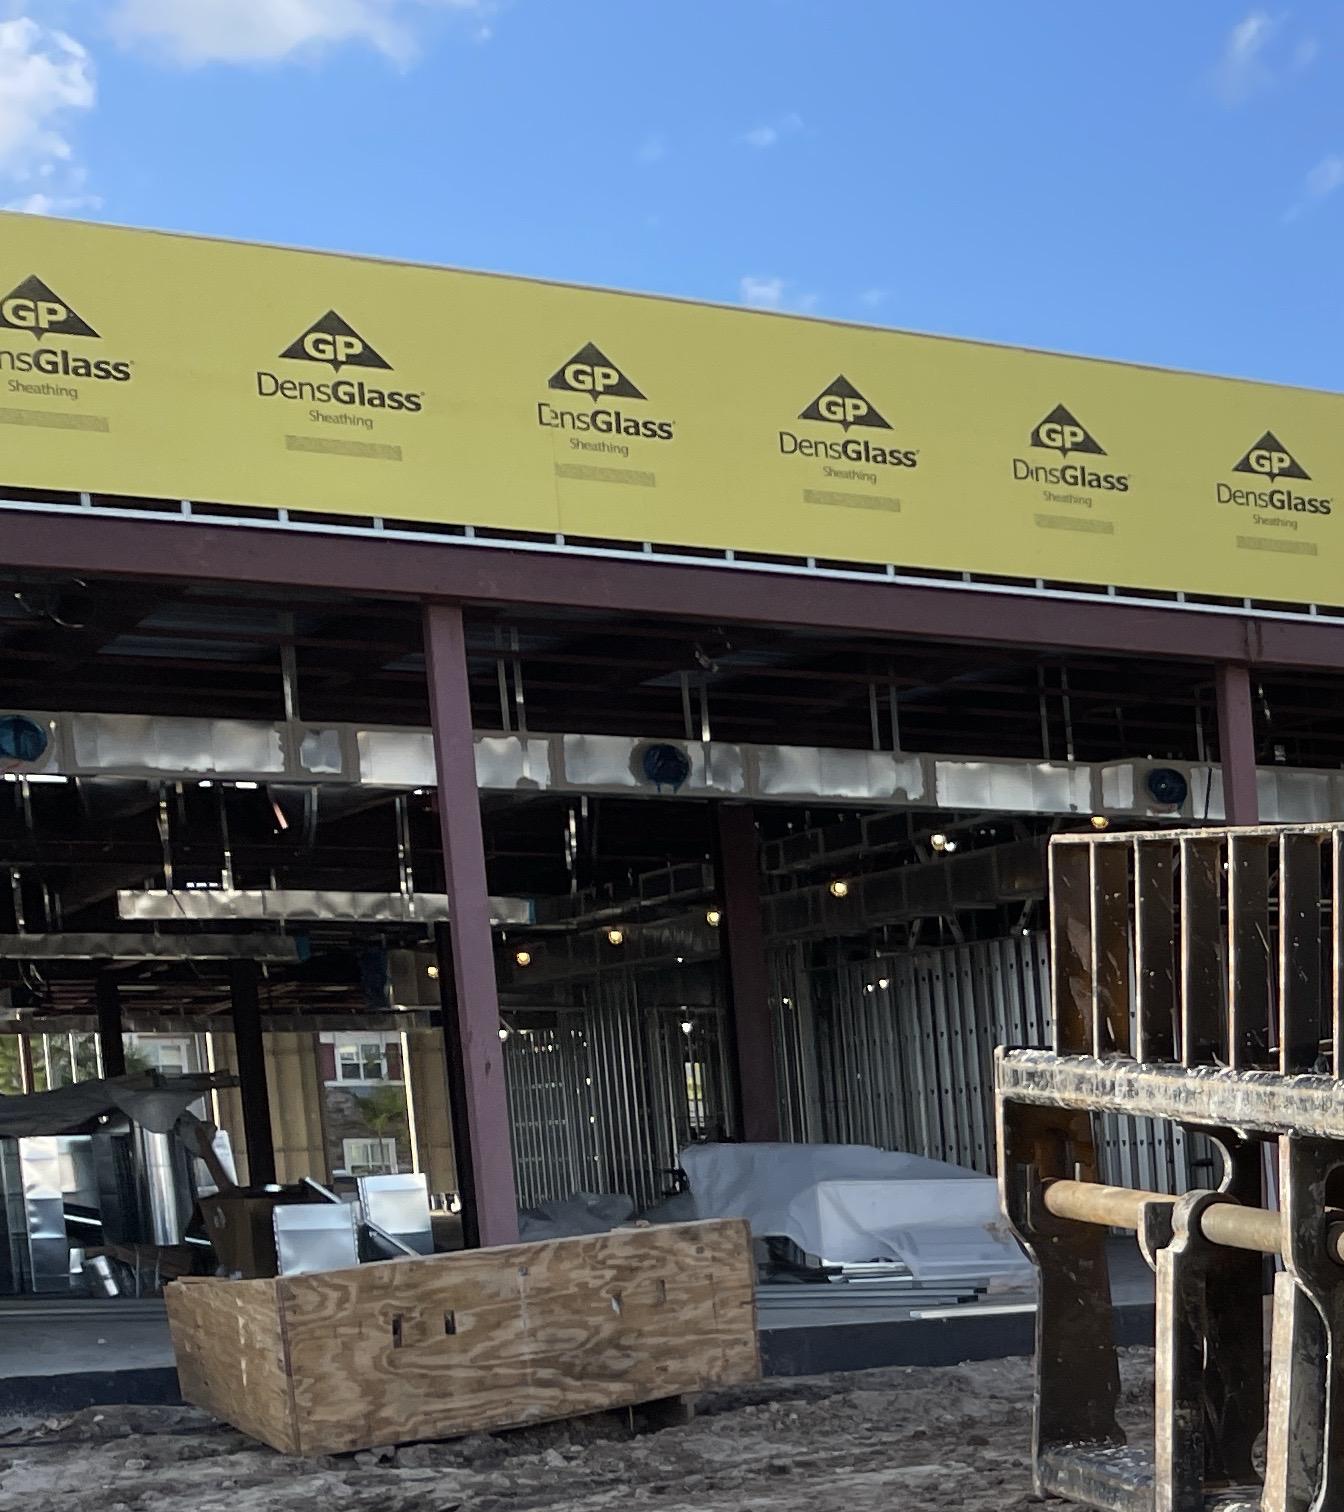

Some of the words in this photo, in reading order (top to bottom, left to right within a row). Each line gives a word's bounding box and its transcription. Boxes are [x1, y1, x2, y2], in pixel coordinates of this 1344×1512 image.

[2, 297, 68, 329] GP
[303, 332, 363, 362] GP
[8, 379, 78, 401] Sheathing
[564, 362, 619, 392] GP
[256, 371, 423, 413] DensGlass
[309, 409, 374, 431] Sheathing
[818, 394, 868, 422] GP
[569, 437, 630, 458] Sheathing
[778, 430, 918, 468] DensGlass
[1039, 422, 1085, 449] GP
[1248, 448, 1291, 475] GP
[1216, 482, 1332, 515] DensGlass
